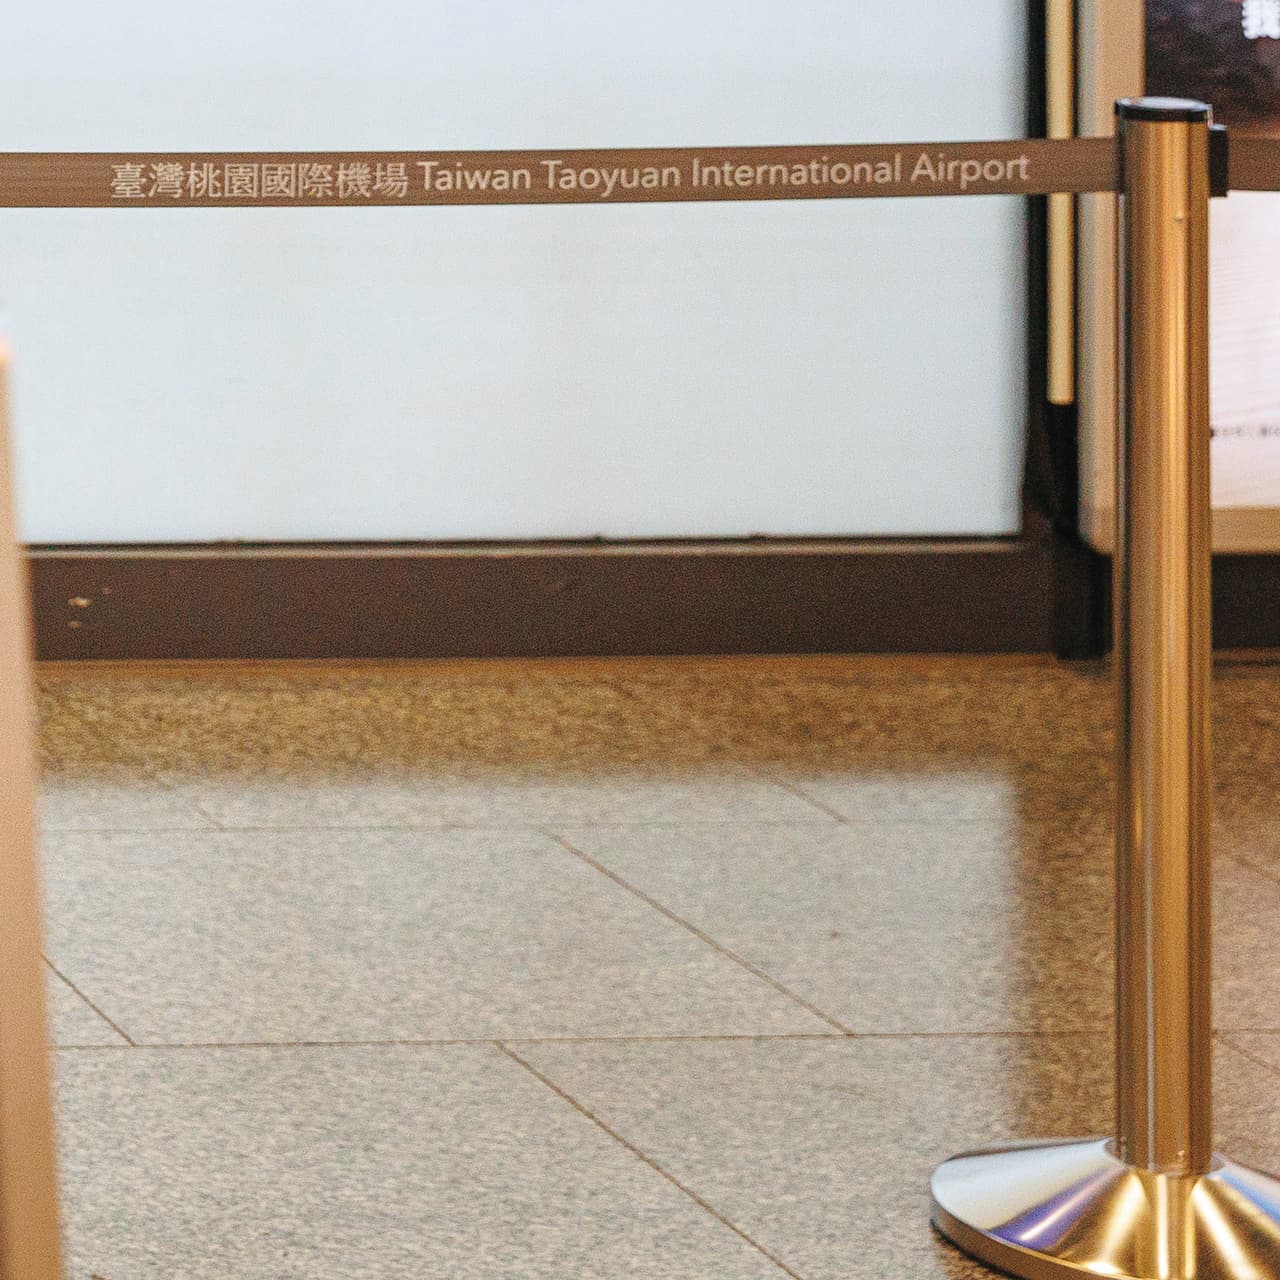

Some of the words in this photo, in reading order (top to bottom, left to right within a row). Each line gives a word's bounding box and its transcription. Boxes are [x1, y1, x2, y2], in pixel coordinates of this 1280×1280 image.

[110, 160, 408, 199] 臺灣桃園國際機場
[417, 160, 532, 191] Taiwan
[542, 159, 680, 197] Taoyuan
[692, 153, 902, 187] International
[911, 153, 1029, 189] Airport
